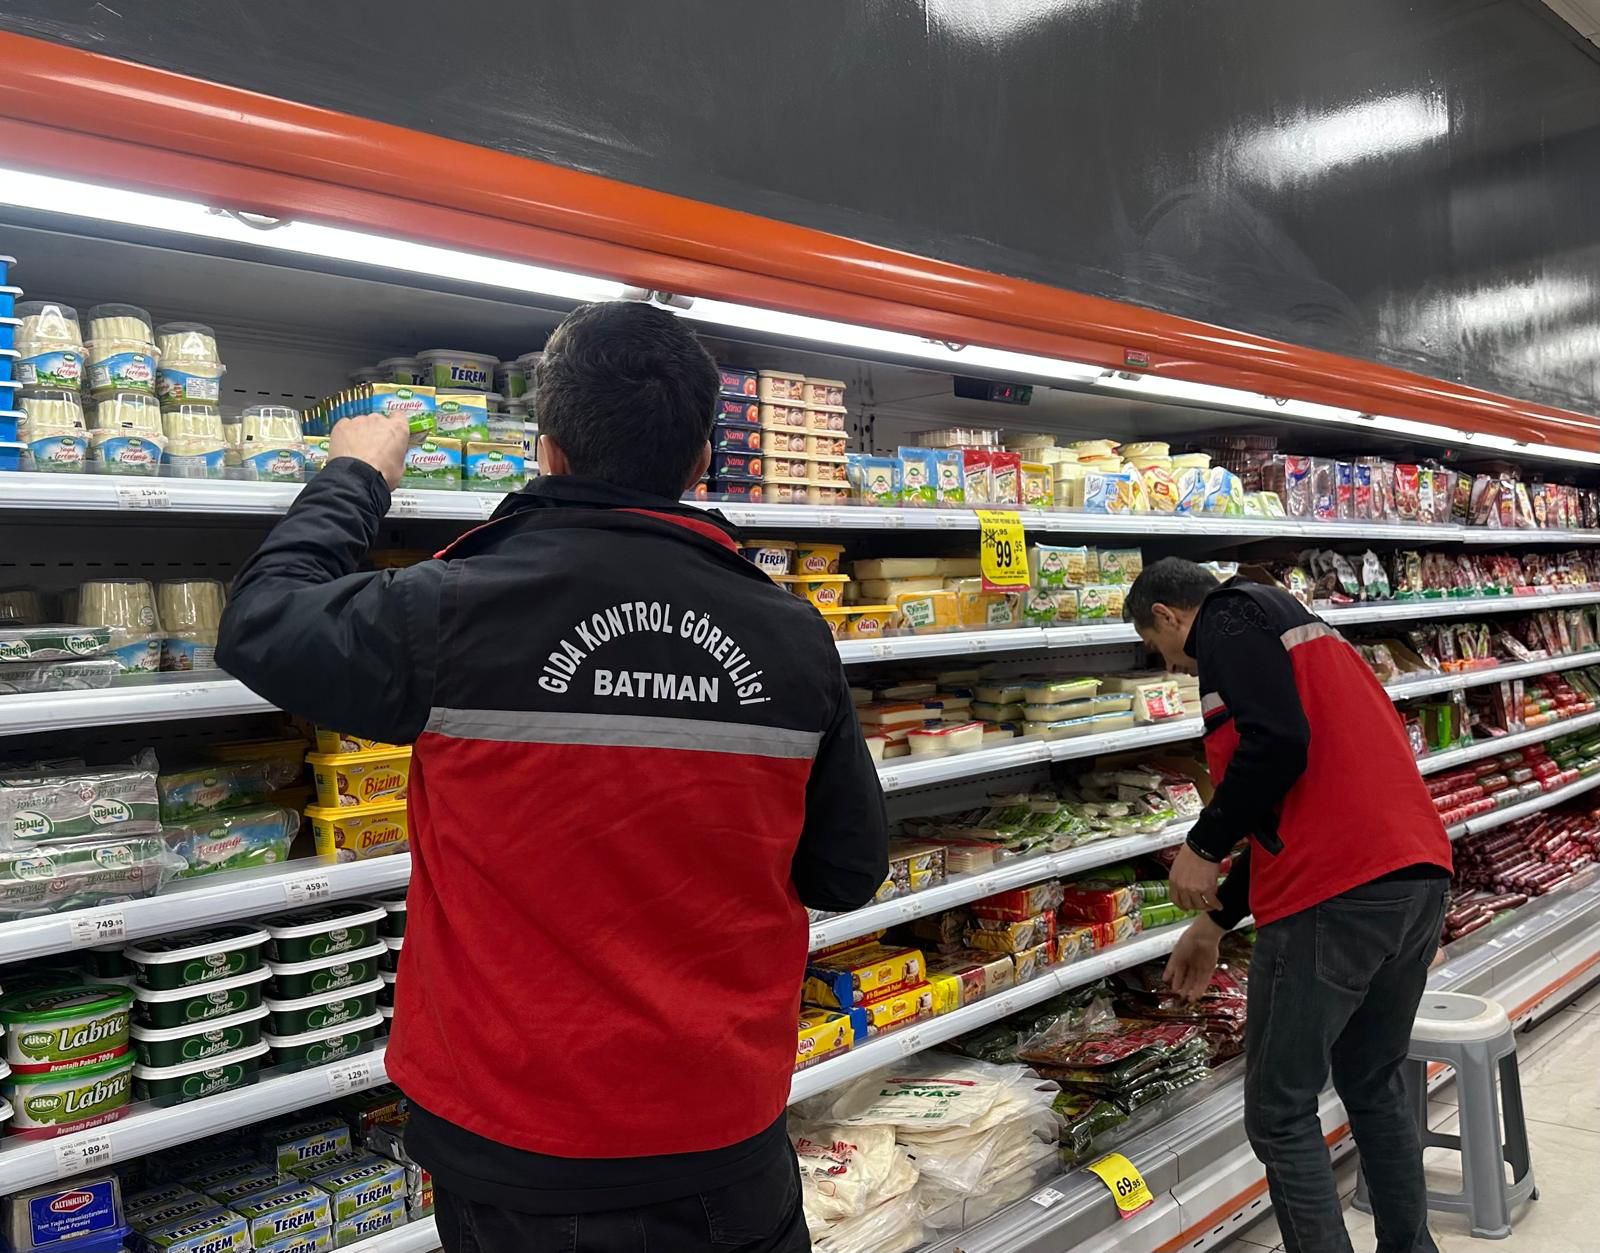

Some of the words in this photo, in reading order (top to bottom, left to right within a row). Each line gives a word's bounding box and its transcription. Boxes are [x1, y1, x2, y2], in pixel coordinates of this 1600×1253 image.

[450, 366, 487, 383] TEREM
[723, 402, 742, 413] Sana
[724, 430, 744, 440] Sana
[725, 456, 744, 466] Sana
[759, 553, 785, 565] TEREM
[807, 557, 824, 568] Halk
[819, 590, 834, 600] Halk
[859, 620, 876, 629] Halk
[538, 640, 587, 693] GIDA
[574, 601, 672, 651] KONTROL
[680, 610, 771, 705] GÖREVLİSİ
[594, 669, 719, 702] BATMAN
[364, 774, 401, 795] Bizim
[362, 827, 400, 848] Bizim
[325, 938, 352, 953] Labne
[201, 964, 231, 980] Labne
[326, 973, 353, 988] Labne
[203, 1001, 234, 1017] Labne
[322, 1009, 349, 1026] Labne
[59, 1016, 124, 1051] Labne
[200, 1040, 229, 1056] Labne
[322, 1045, 348, 1061] Labne
[80, 1058, 97, 1067] Paket
[200, 1076, 229, 1093] Labne
[65, 1075, 127, 1113] Labne
[86, 1118, 103, 1128] Paket
[298, 1139, 336, 1161] TEREM
[306, 1151, 359, 1172] TEREM
[332, 1163, 386, 1186] TEREM
[250, 1190, 311, 1212] TEREM
[356, 1183, 392, 1206] TEREM
[141, 1201, 203, 1225] TEREM
[165, 1215, 228, 1240] TEREM
[274, 1210, 314, 1234] TEREM
[356, 1212, 392, 1236] TEREM
[190, 1236, 233, 1253] TEREM
